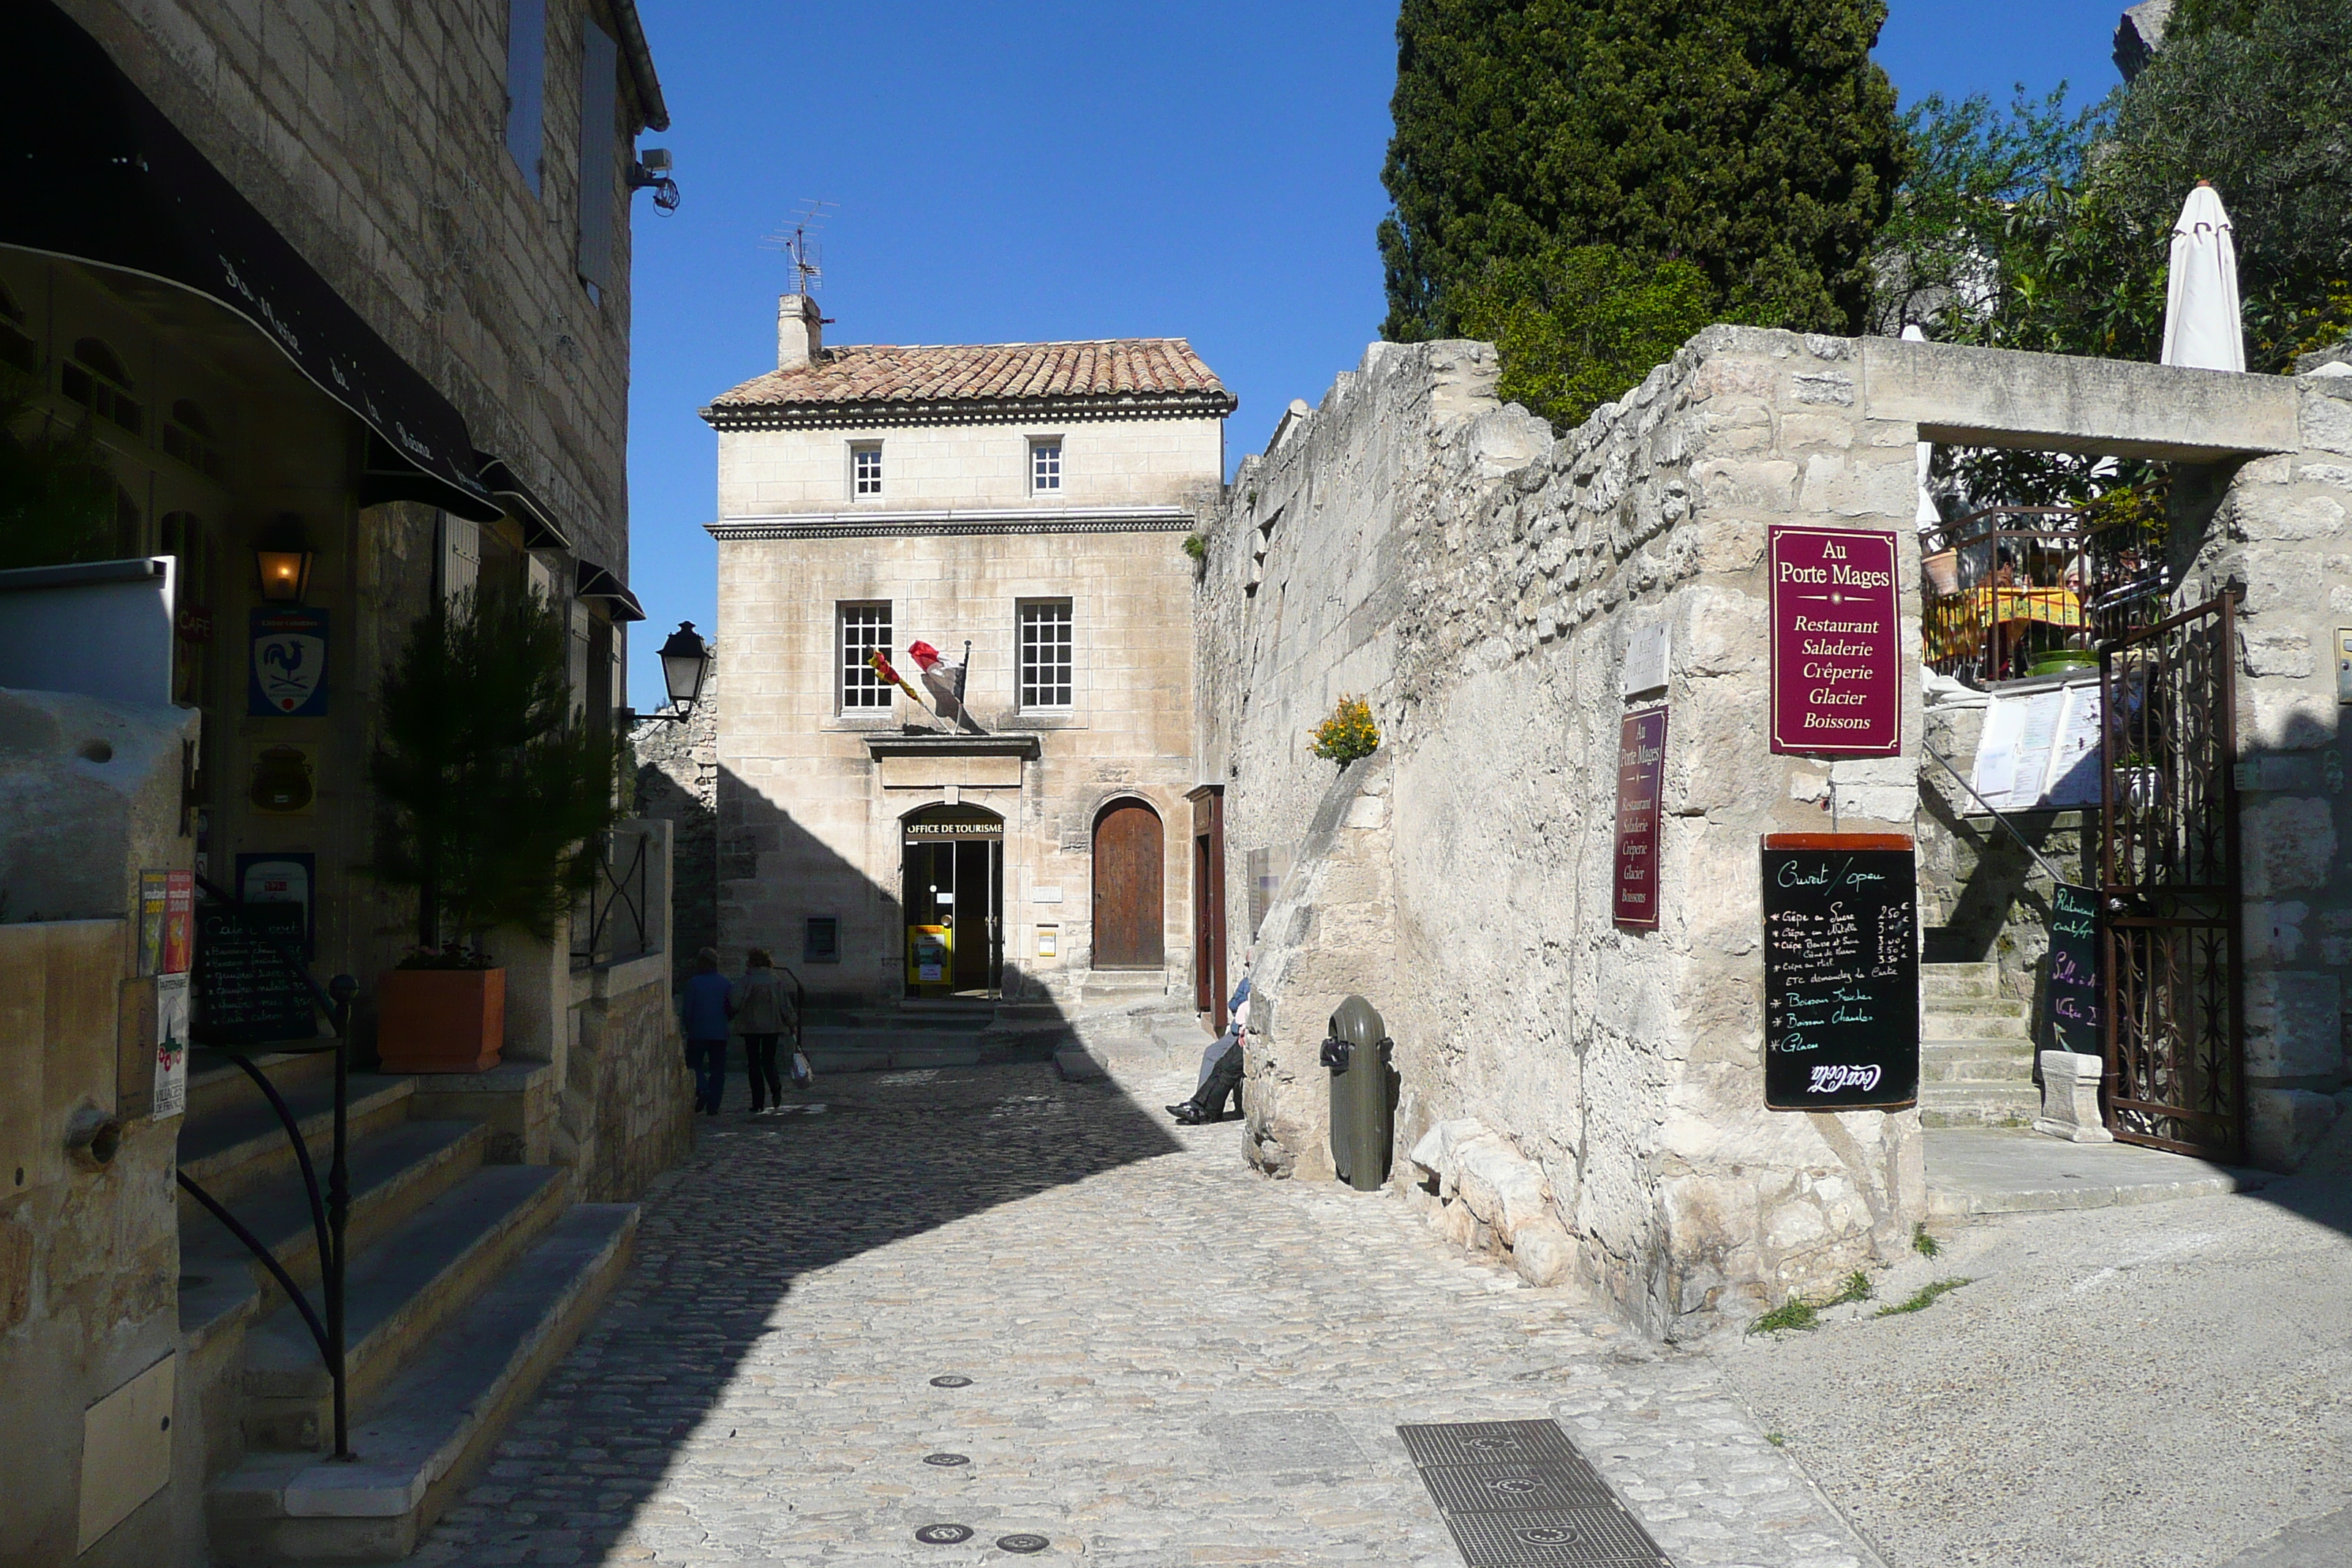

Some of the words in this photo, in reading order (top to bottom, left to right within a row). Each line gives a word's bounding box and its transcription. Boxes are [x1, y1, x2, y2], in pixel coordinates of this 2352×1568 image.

[1822, 540, 1847, 559] Au
[1779, 562, 1828, 584] Porte
[1831, 564, 1890, 589] Mages
[1793, 616, 1880, 634] Restaurant
[1801, 638, 1873, 656] Saladerie
[1803, 661, 1873, 685] Crêperie
[1809, 688, 1867, 706] Glacier
[1803, 712, 1871, 730] Boissons
[1635, 723, 1646, 741] Au
[1620, 747, 1637, 768] Porte
[1637, 745, 1660, 766] Mages
[1621, 796, 1651, 813] Restaurant
[907, 824, 940, 834] OFFICE
[941, 824, 954, 833] DE
[954, 823, 1003, 833] TOURISME
[1622, 817, 1648, 834] Saladerie
[1622, 840, 1648, 862] Crêperie
[1623, 864, 1646, 881] Glacier
[1777, 860, 1828, 888] Ouvert
[1621, 887, 1646, 904] Boissons
[1785, 976, 1806, 987] ETC
[1806, 1063, 1881, 1093] Coca-Cola
